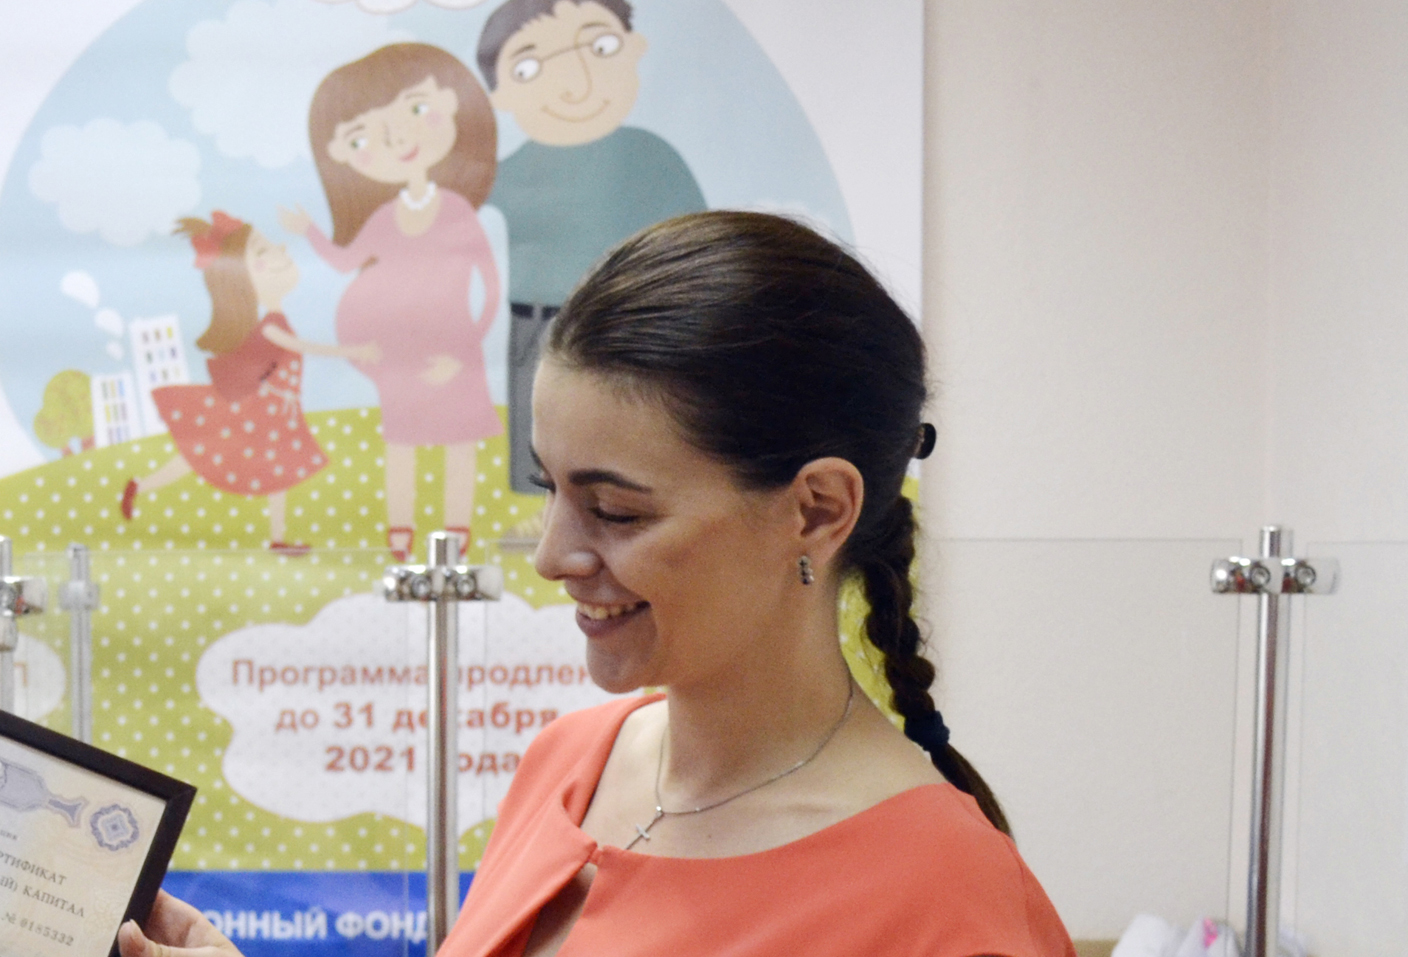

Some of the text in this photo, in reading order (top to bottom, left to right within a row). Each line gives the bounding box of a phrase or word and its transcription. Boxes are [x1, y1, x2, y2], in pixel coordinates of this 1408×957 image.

[232, 659, 589, 692] Программа родлен
[275, 701, 558, 734] до 31 деабря
[325, 746, 522, 776] 2021 ода
[21, 884, 88, 918] КАПИТАЛ
[203, 906, 428, 944] ОННЫЙ ФОНД
